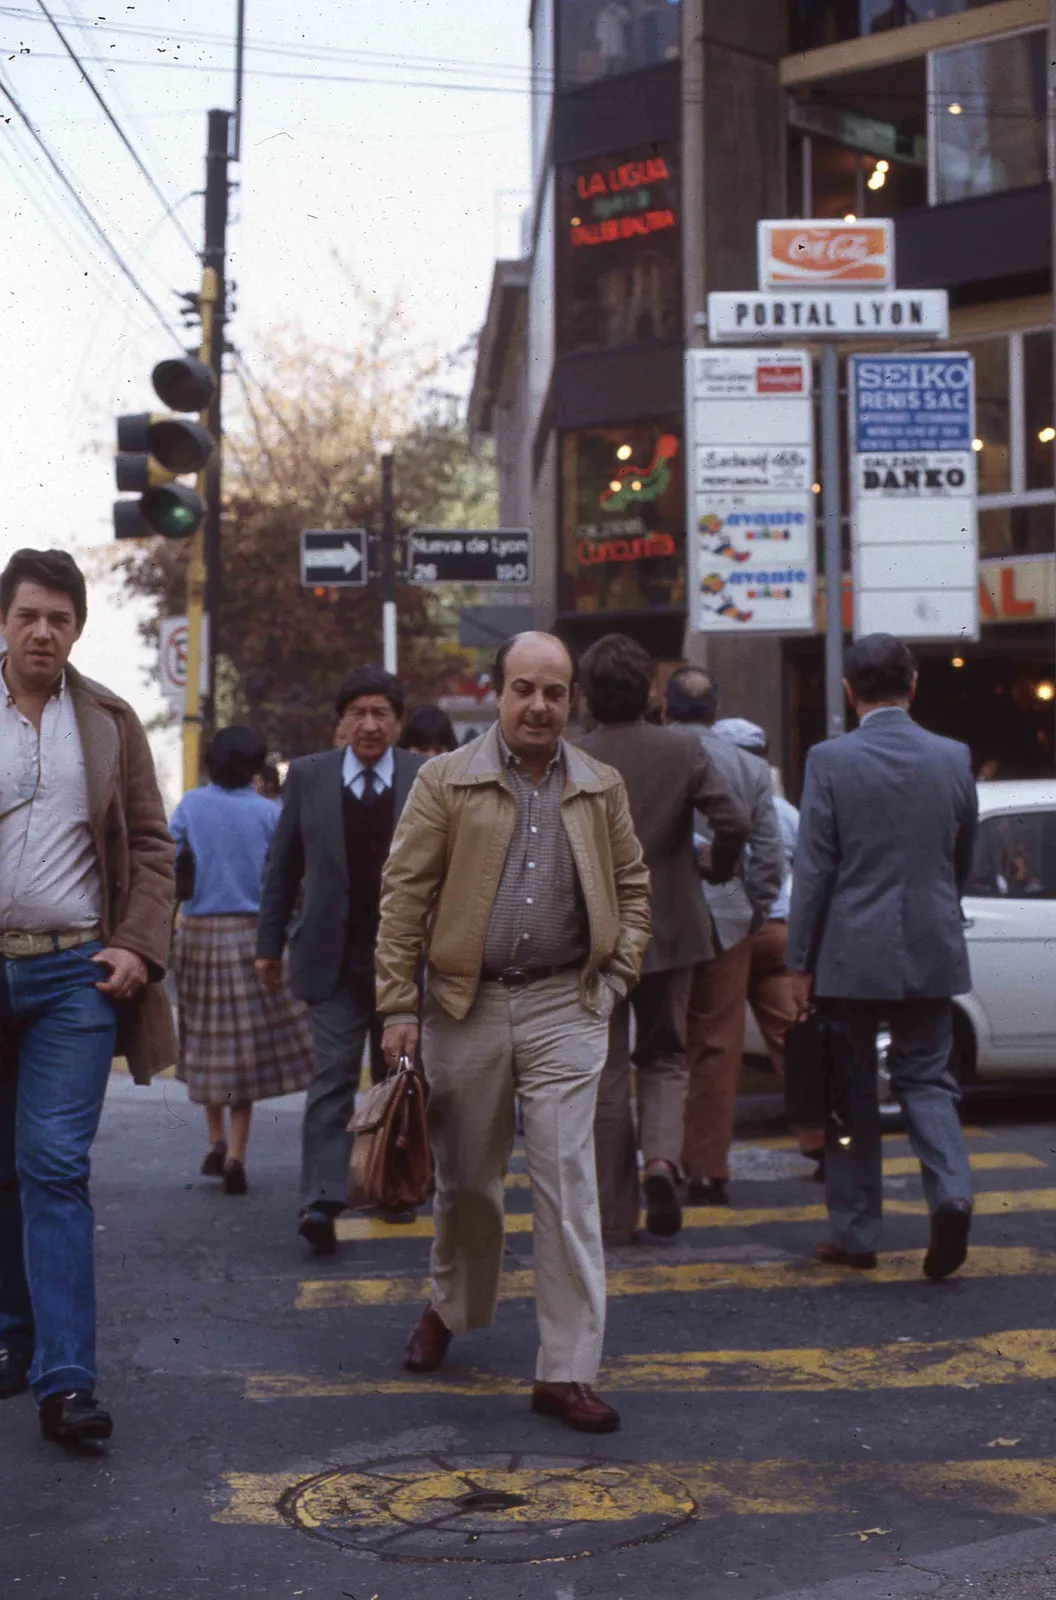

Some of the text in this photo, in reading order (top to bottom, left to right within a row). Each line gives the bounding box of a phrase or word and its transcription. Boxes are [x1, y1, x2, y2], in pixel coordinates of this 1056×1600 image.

[736, 301, 923, 326] PORTAL LYON
[858, 363, 971, 389] SEIKO
[411, 536, 528, 558] Nueva de Lyon
